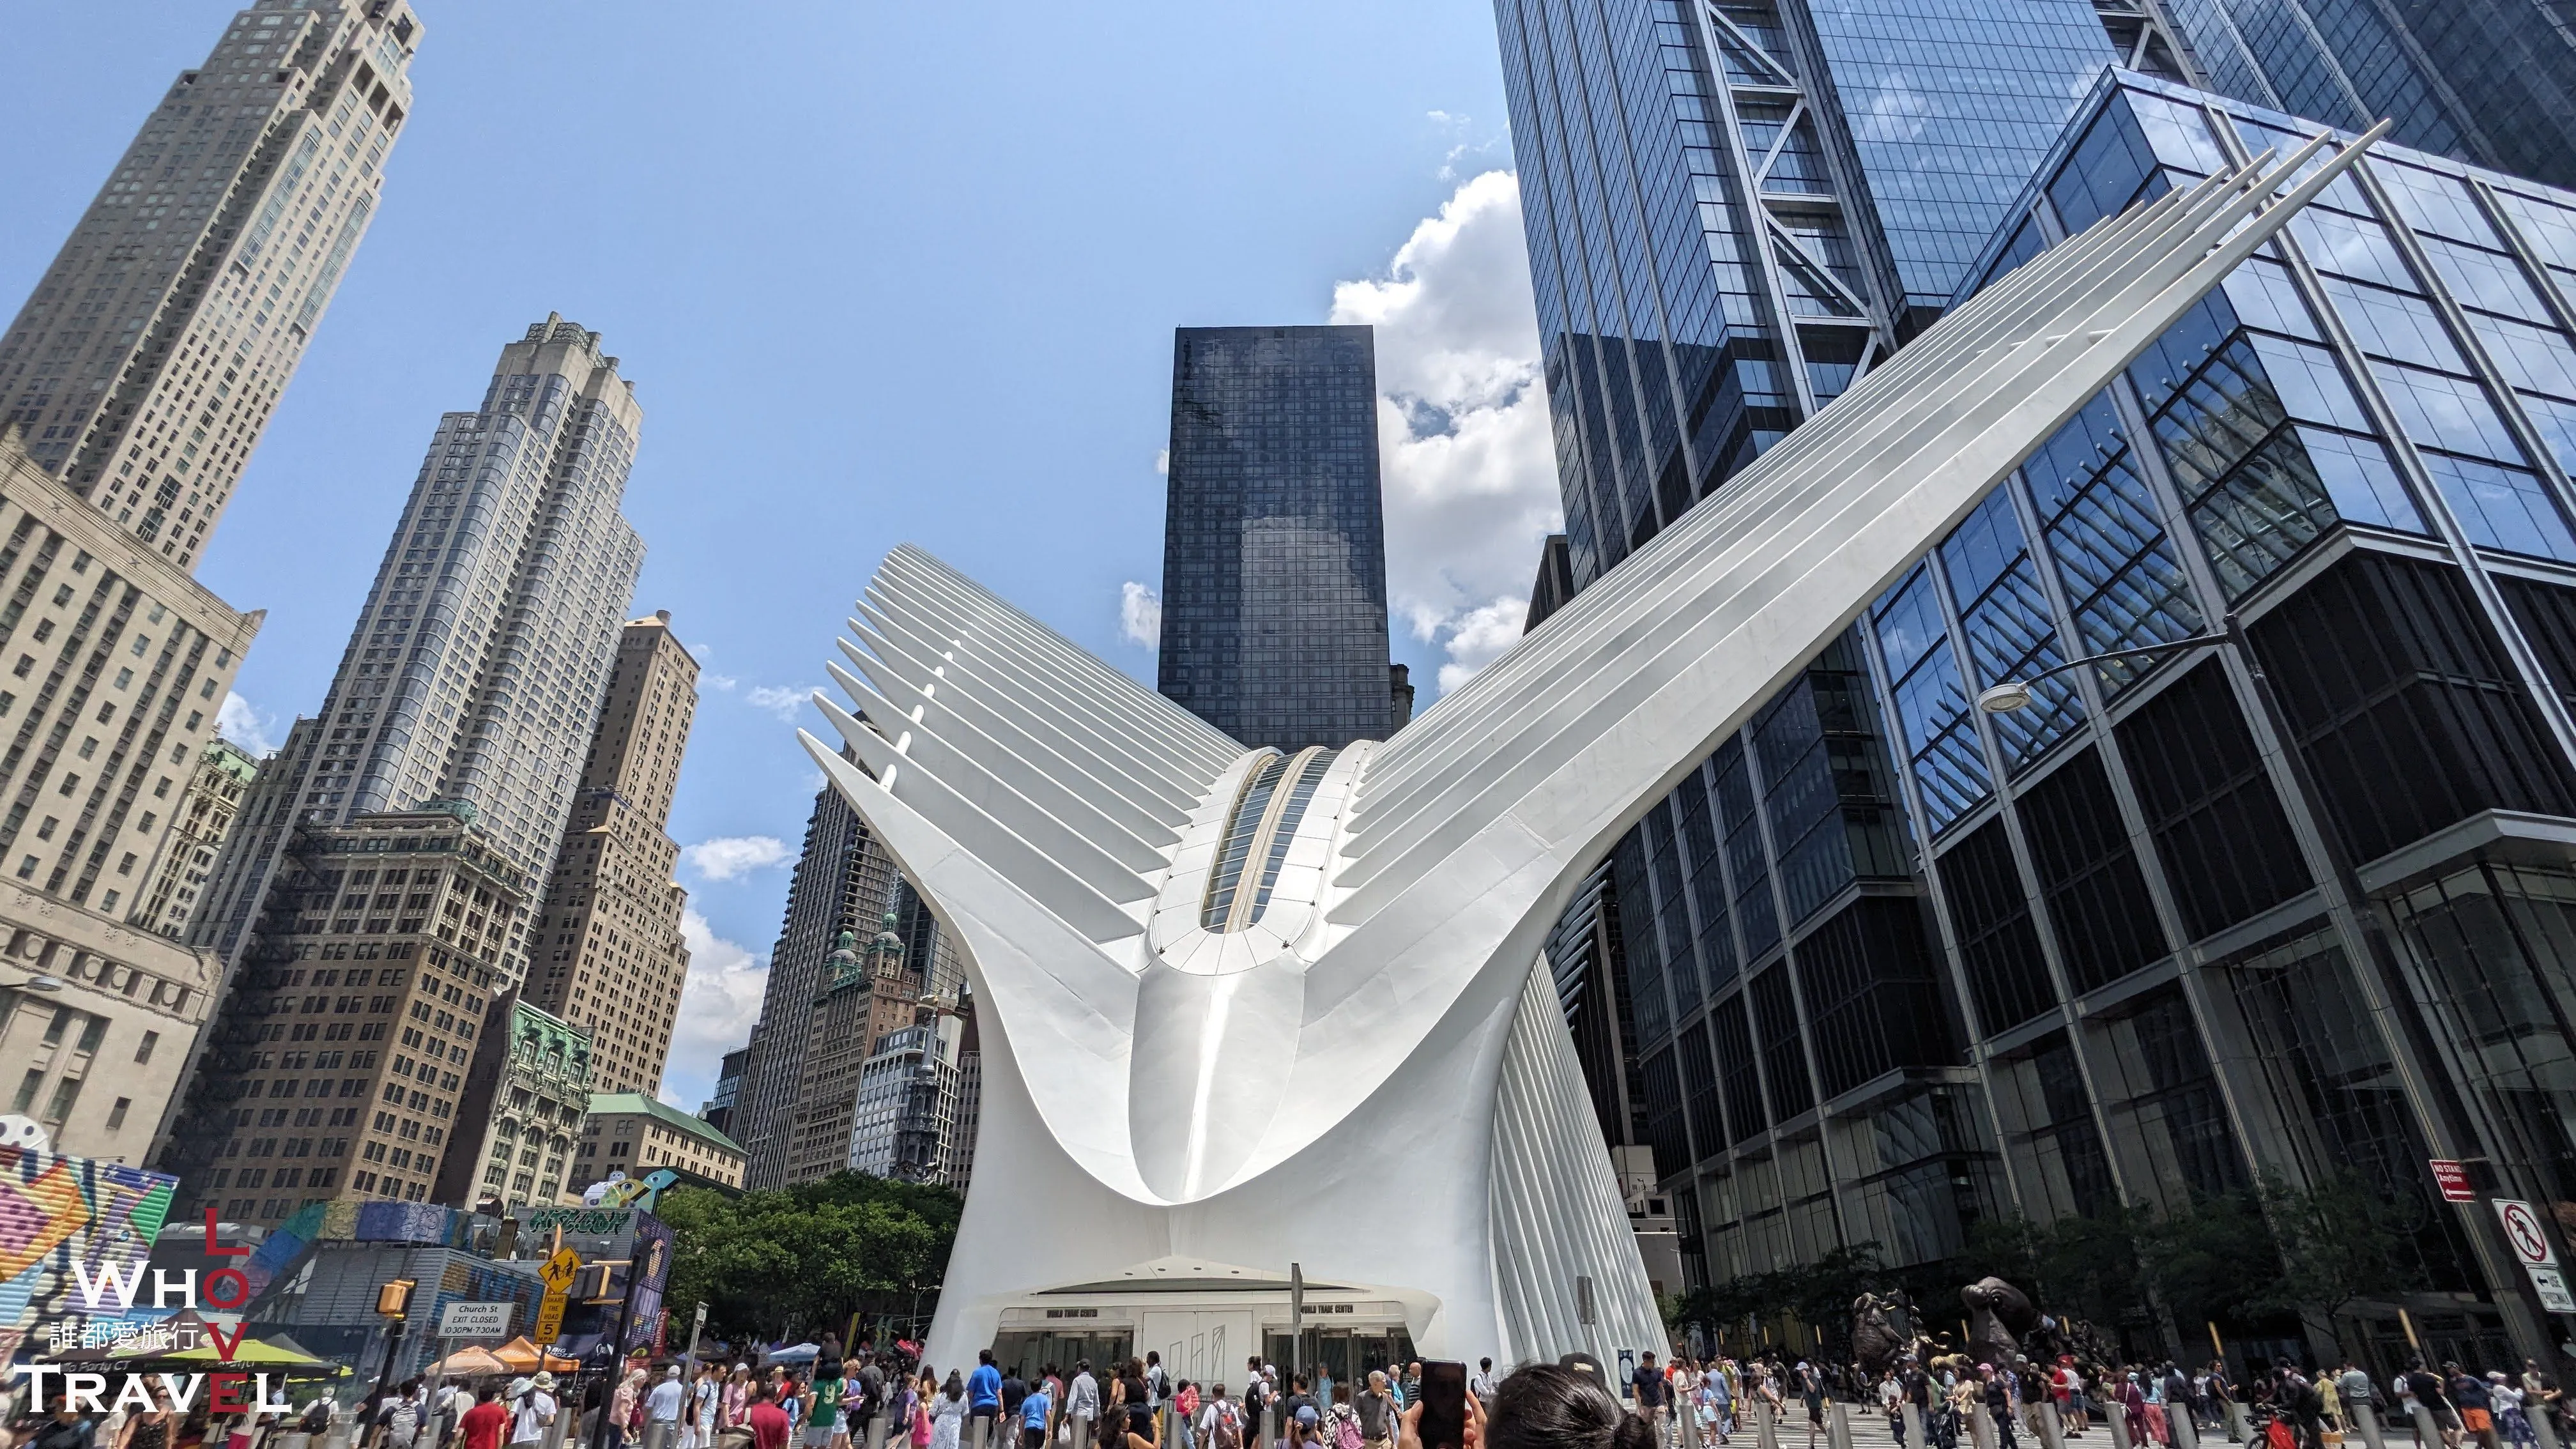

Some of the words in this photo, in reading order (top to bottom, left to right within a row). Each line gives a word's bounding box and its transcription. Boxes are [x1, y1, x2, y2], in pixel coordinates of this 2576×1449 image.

[2434, 1165, 2444, 1173] NO
[1080, 1308, 1098, 1317] CENTER
[1318, 1305, 1333, 1314] TRADE
[1335, 1305, 1353, 1313] CENTER
[543, 1324, 553, 1335] 5
[824, 1384, 836, 1404] 9
